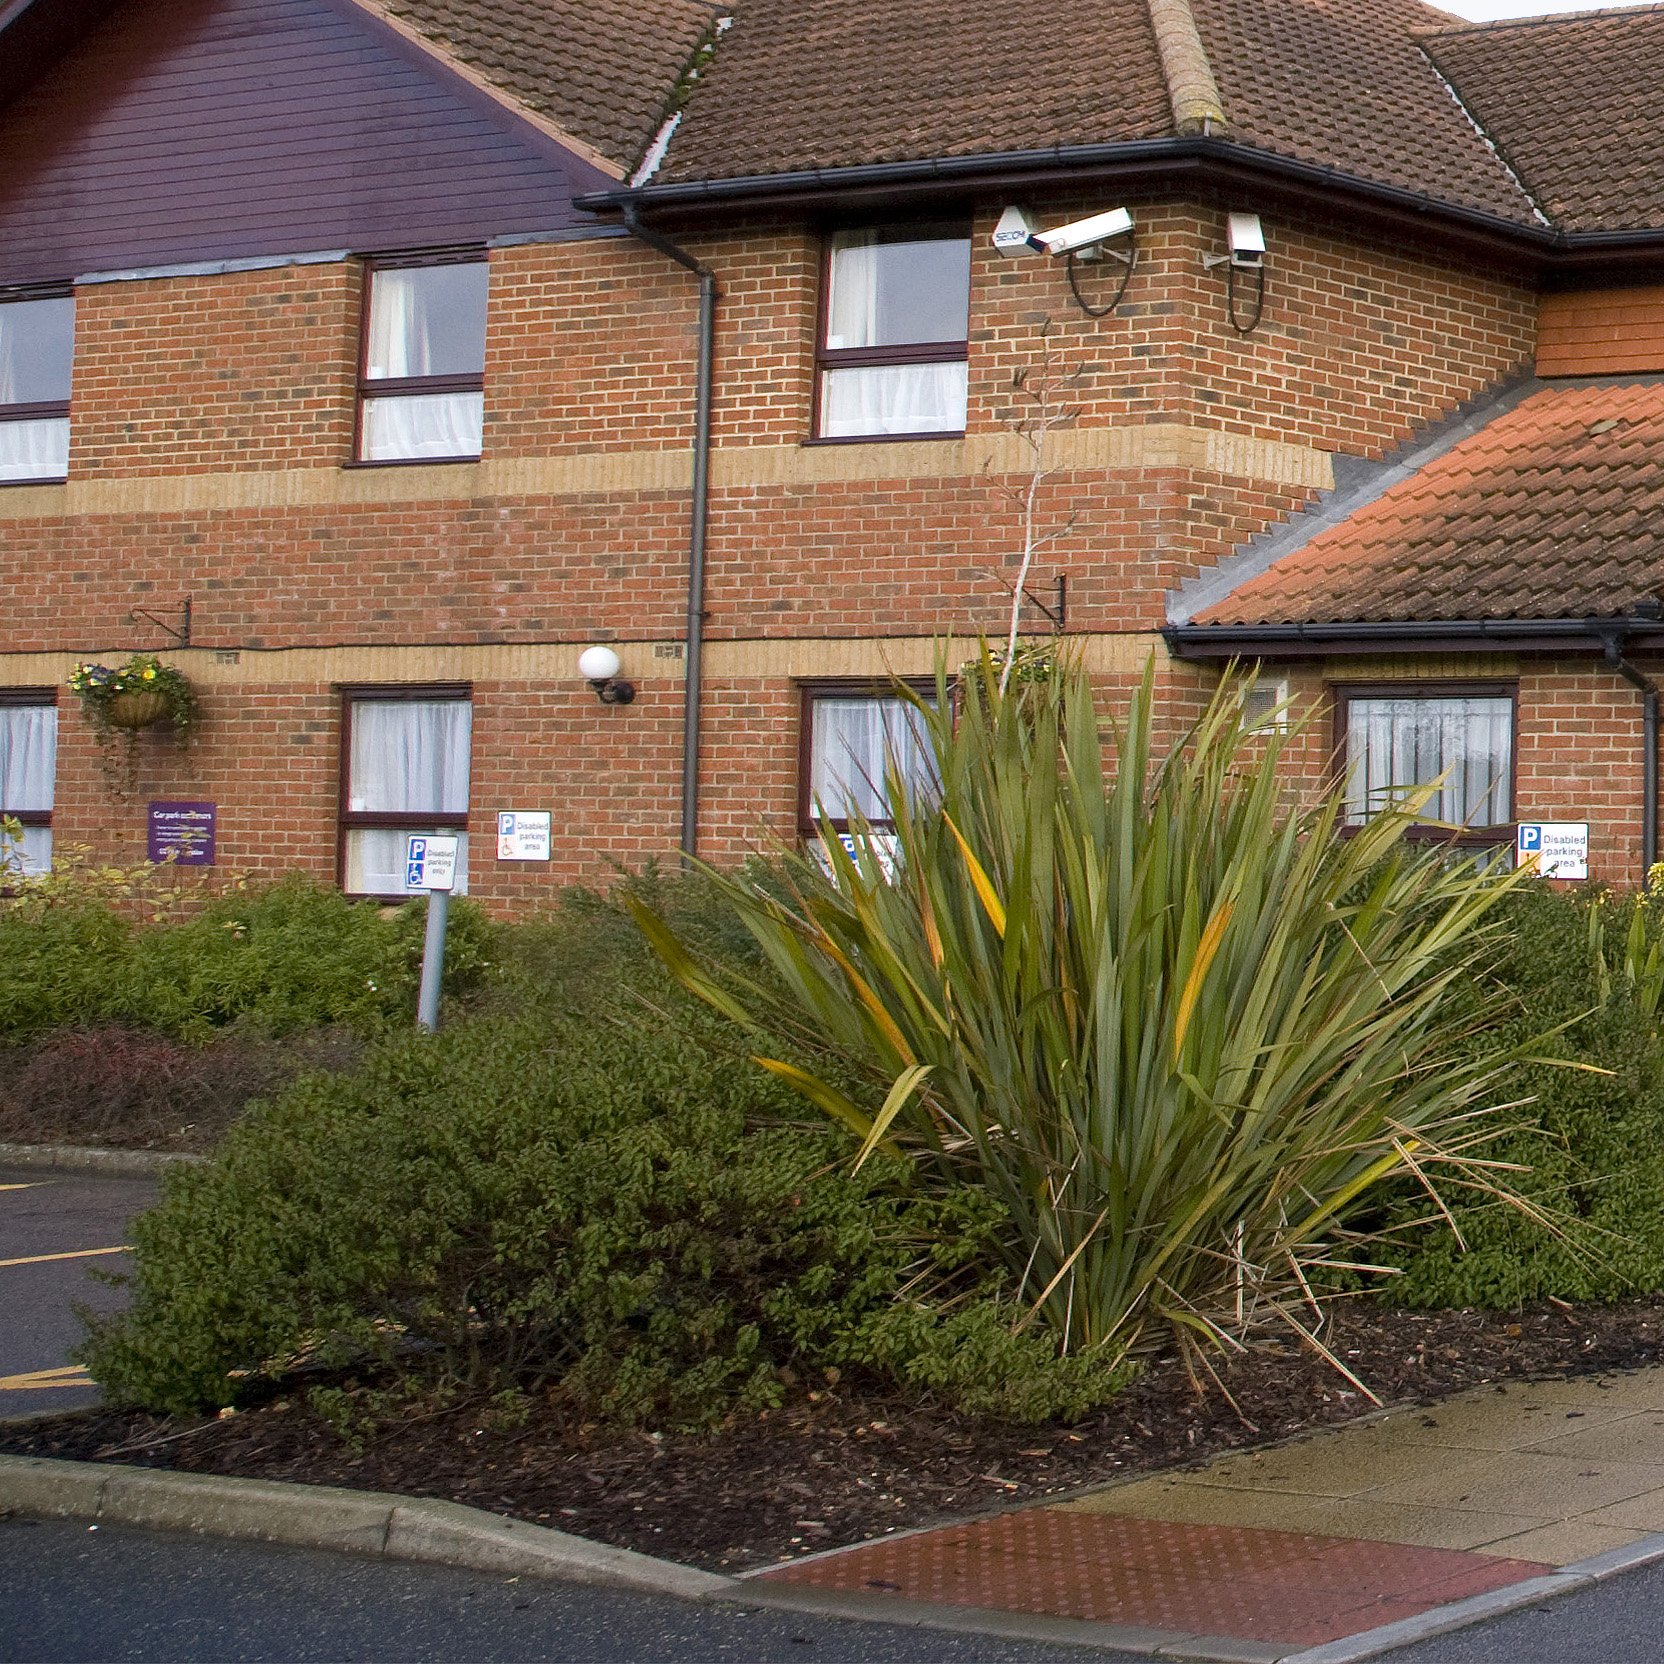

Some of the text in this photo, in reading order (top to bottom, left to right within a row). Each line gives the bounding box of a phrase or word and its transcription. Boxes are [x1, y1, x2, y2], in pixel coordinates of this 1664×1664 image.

[502, 815, 513, 834] P
[1523, 827, 1538, 848] P
[1543, 835, 1586, 845] Disabled
[412, 840, 425, 858] P
[1546, 848, 1583, 858] parking
[1554, 859, 1575, 867] area
